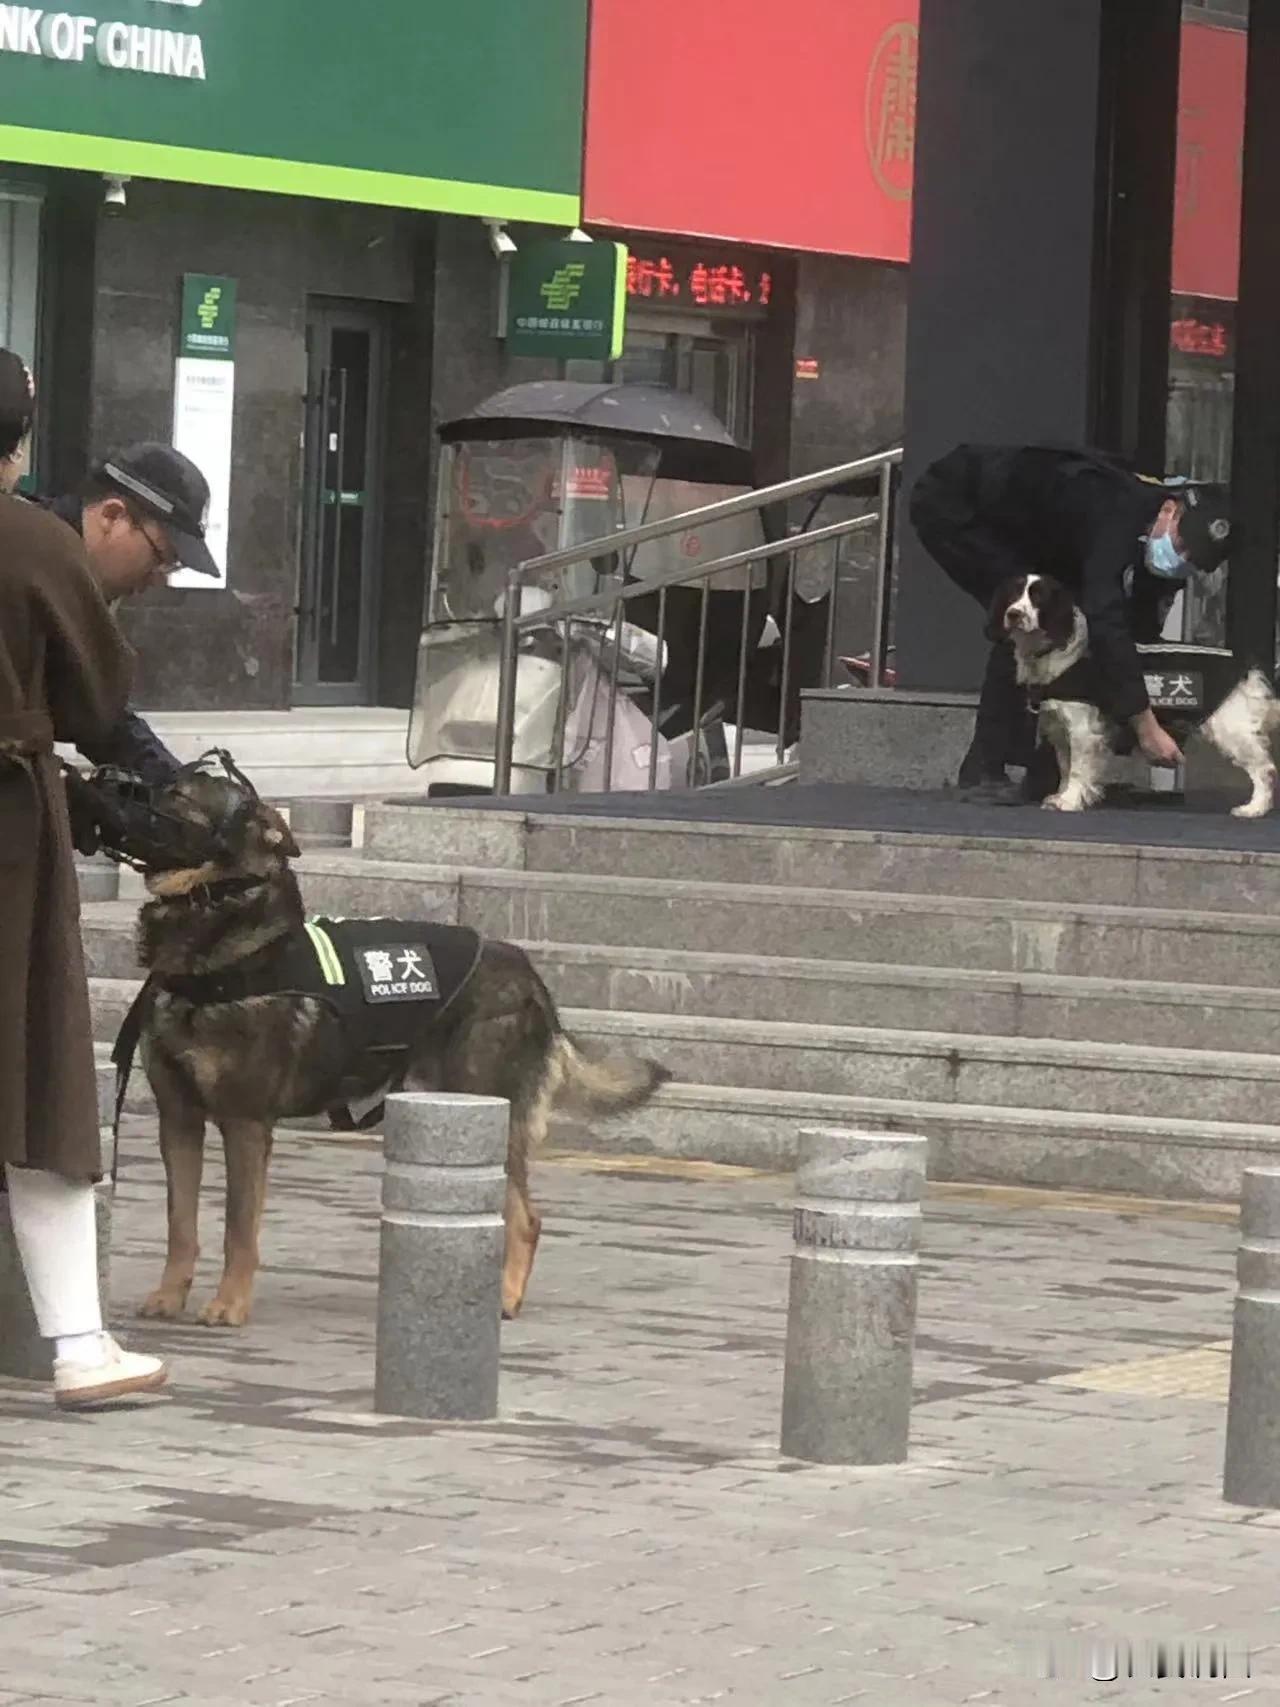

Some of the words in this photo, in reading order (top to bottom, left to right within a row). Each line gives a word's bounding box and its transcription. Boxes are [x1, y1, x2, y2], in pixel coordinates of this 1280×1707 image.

[46, 12, 97, 62] OF
[100, 21, 206, 80] CHINA
[1143, 674, 1193, 696] 警犬
[1175, 697, 1198, 705] DOG
[363, 949, 427, 982] 警犬
[370, 982, 408, 996] POLICE
[409, 981, 433, 993] DOG
